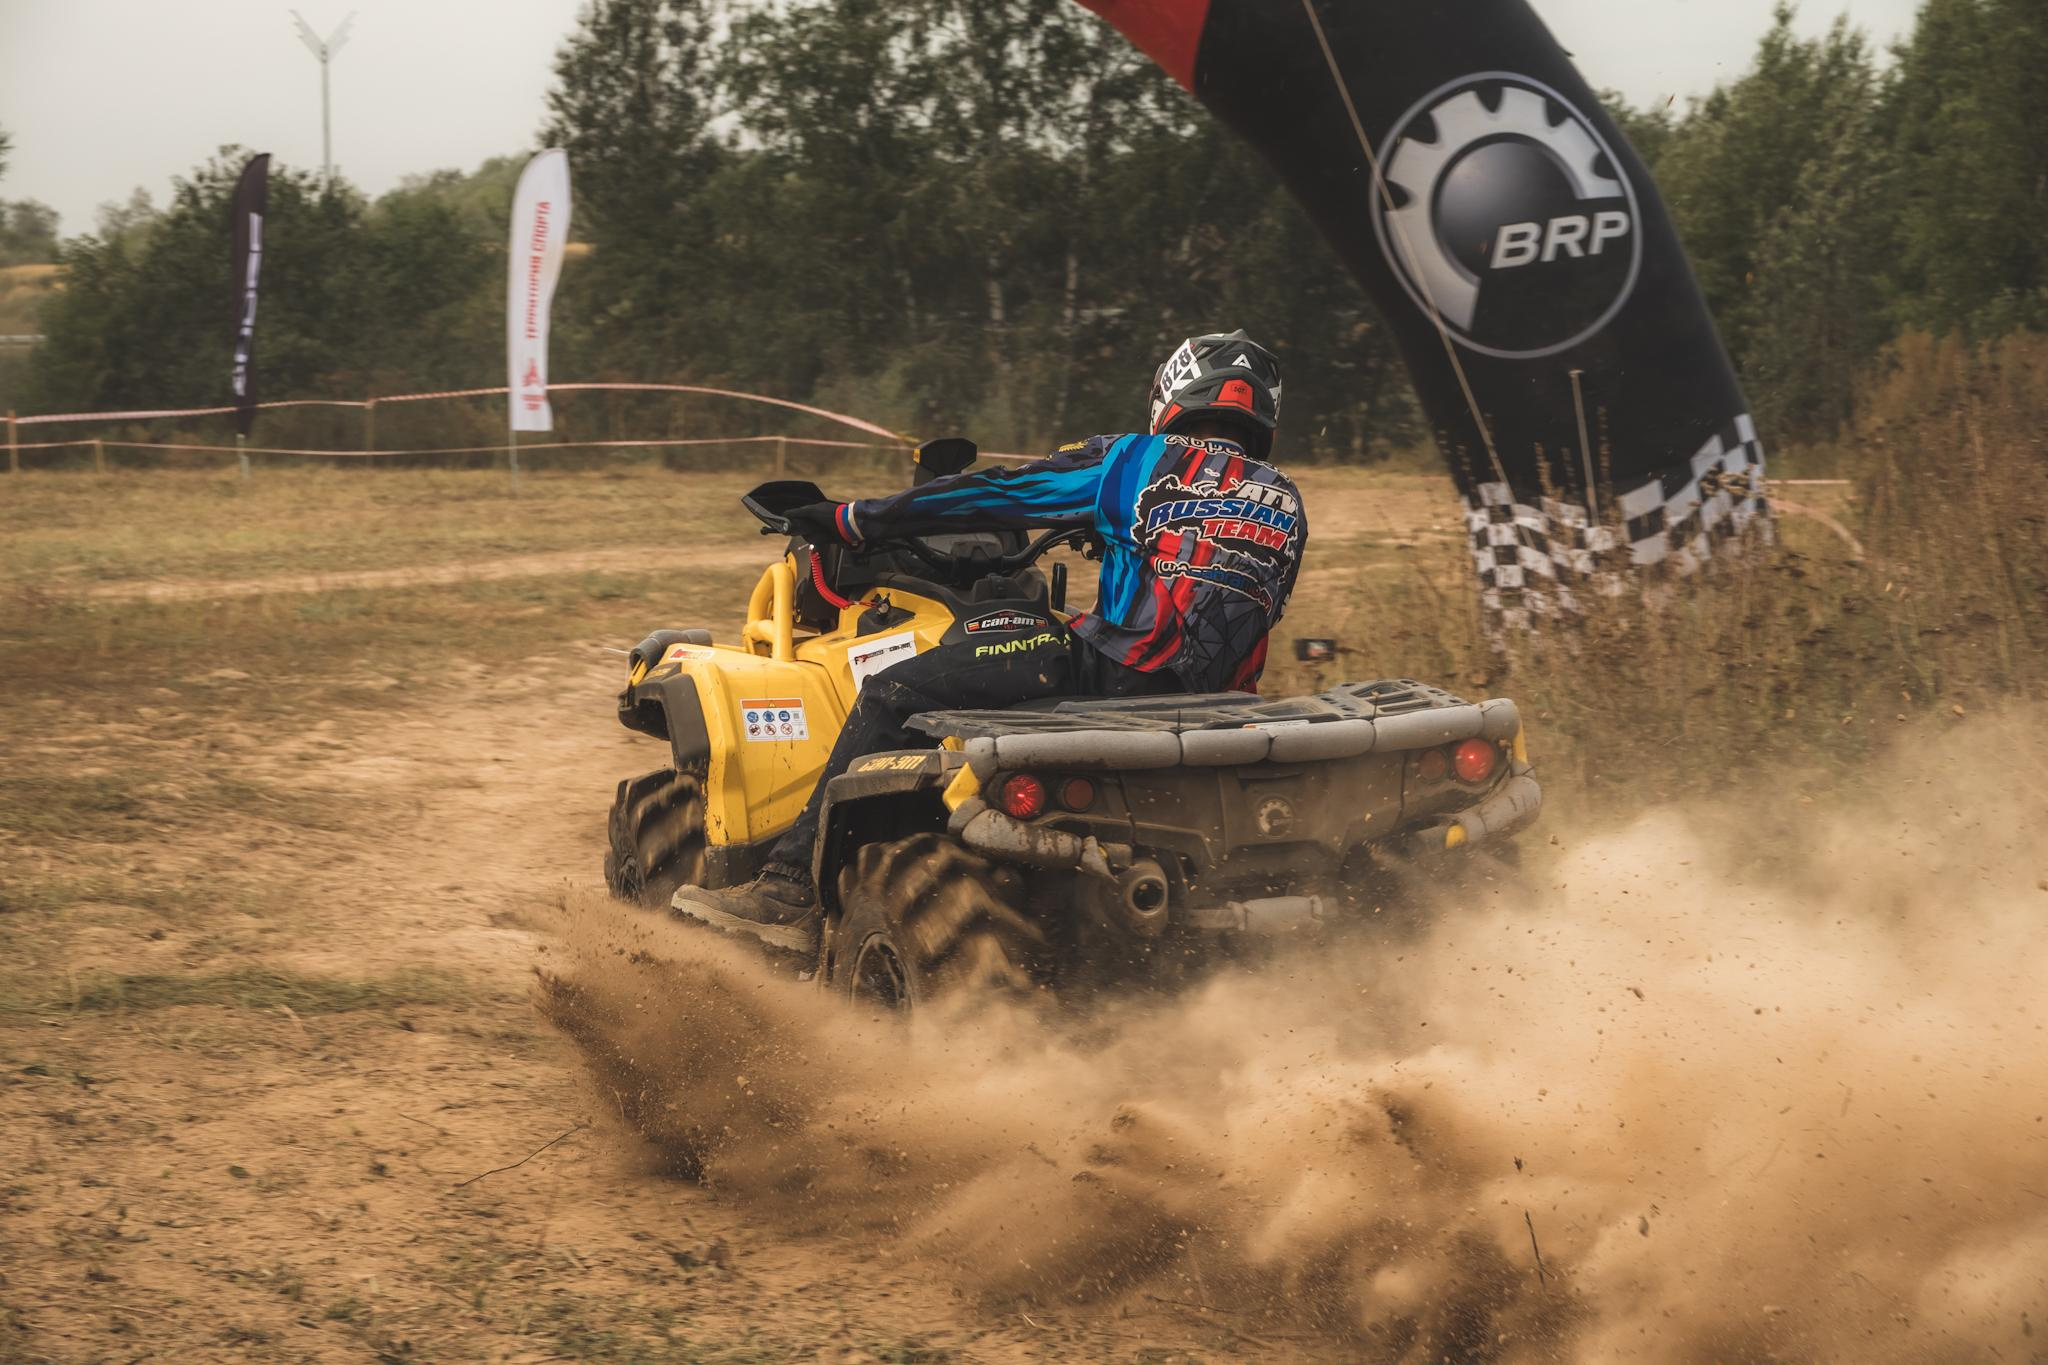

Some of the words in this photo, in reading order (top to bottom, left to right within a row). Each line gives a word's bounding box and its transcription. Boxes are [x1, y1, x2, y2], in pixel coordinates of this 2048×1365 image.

[1490, 211, 1630, 269] BRP
[1161, 347, 1192, 393] 828
[1235, 483, 1297, 513] ATV
[1146, 498, 1296, 533] RUSSIAN
[1202, 519, 1288, 551] TEAM
[981, 616, 1035, 628] can-am
